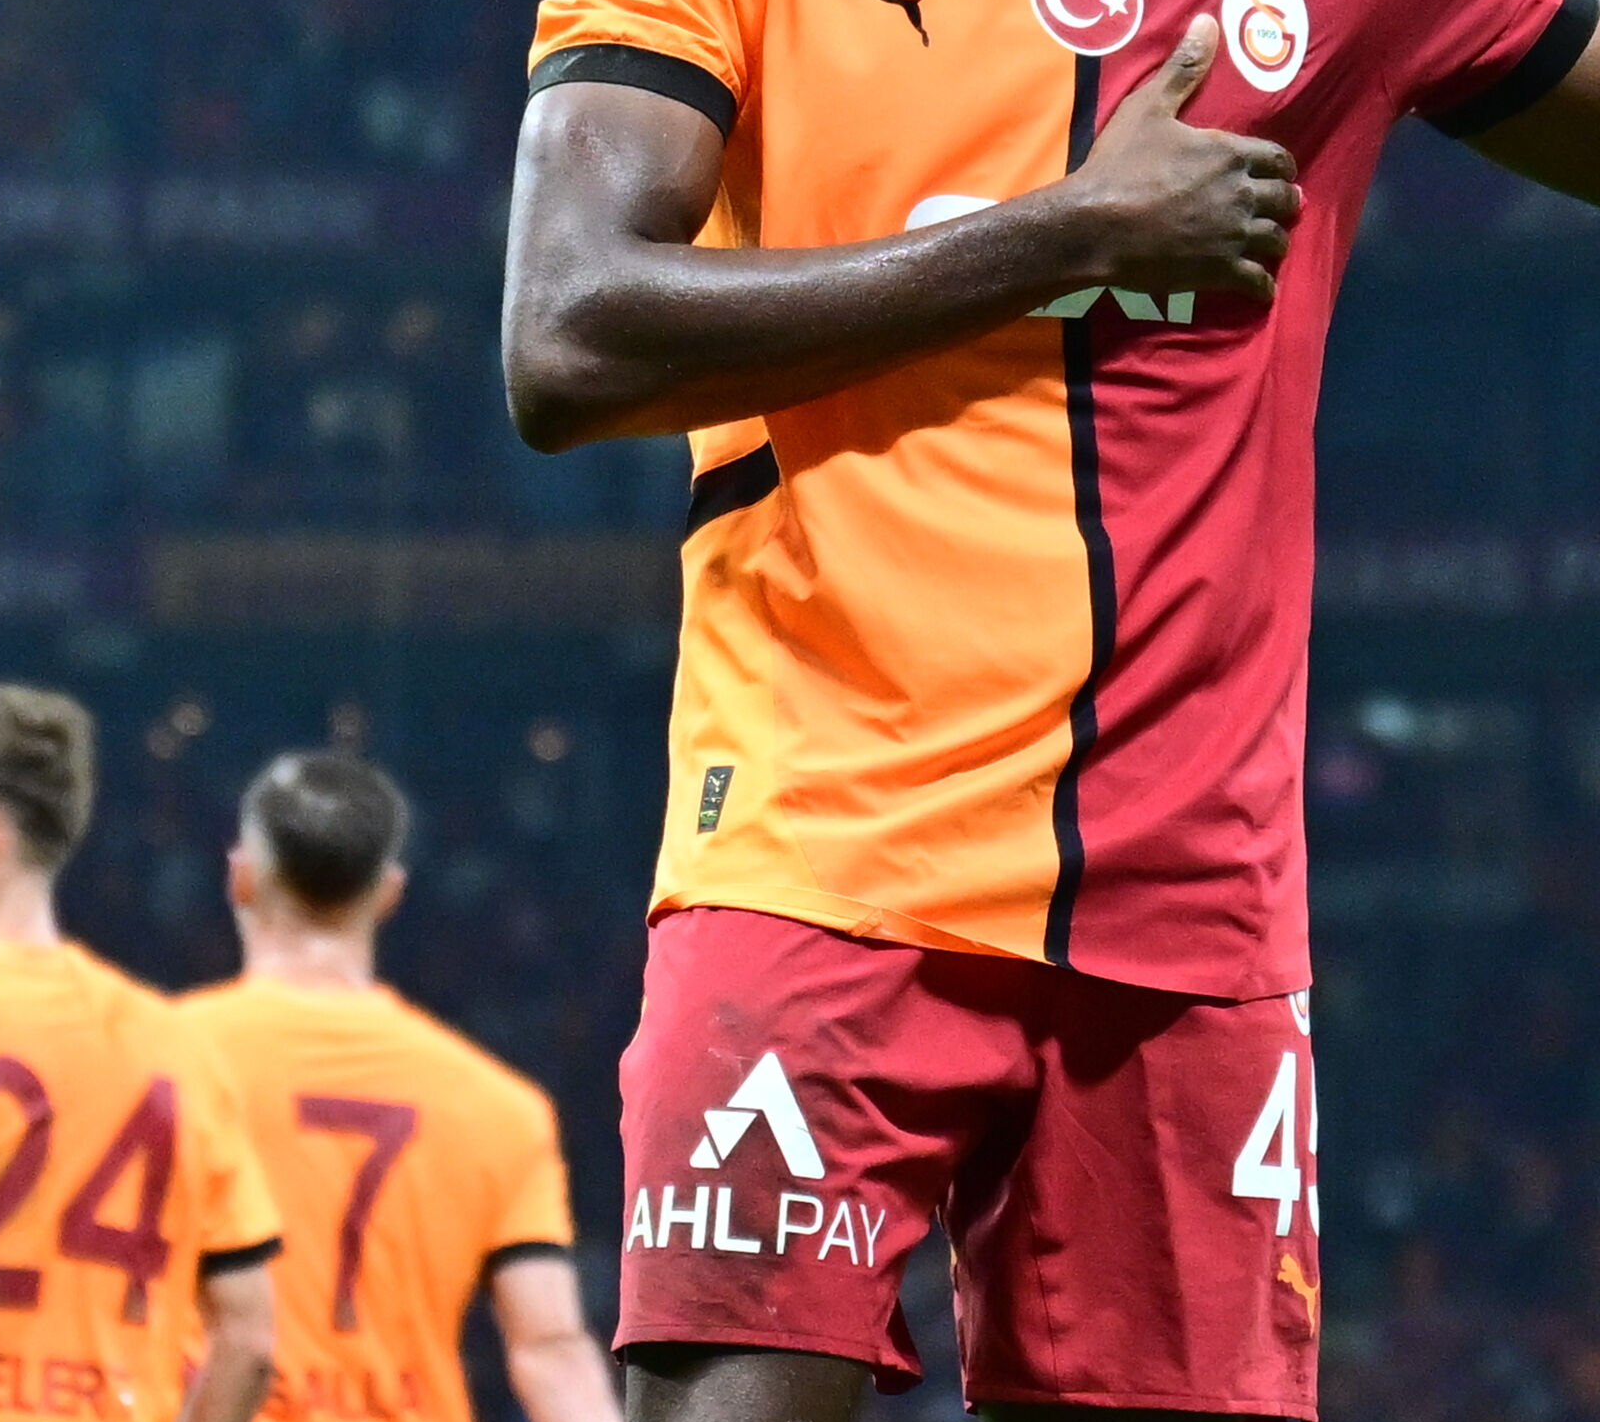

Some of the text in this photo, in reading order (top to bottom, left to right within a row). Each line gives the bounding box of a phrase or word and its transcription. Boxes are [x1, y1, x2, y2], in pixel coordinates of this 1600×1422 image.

[296, 1096, 417, 1333] 7
[626, 1186, 887, 1268] AHL PAY
[1231, 1051, 1319, 1237] 4
